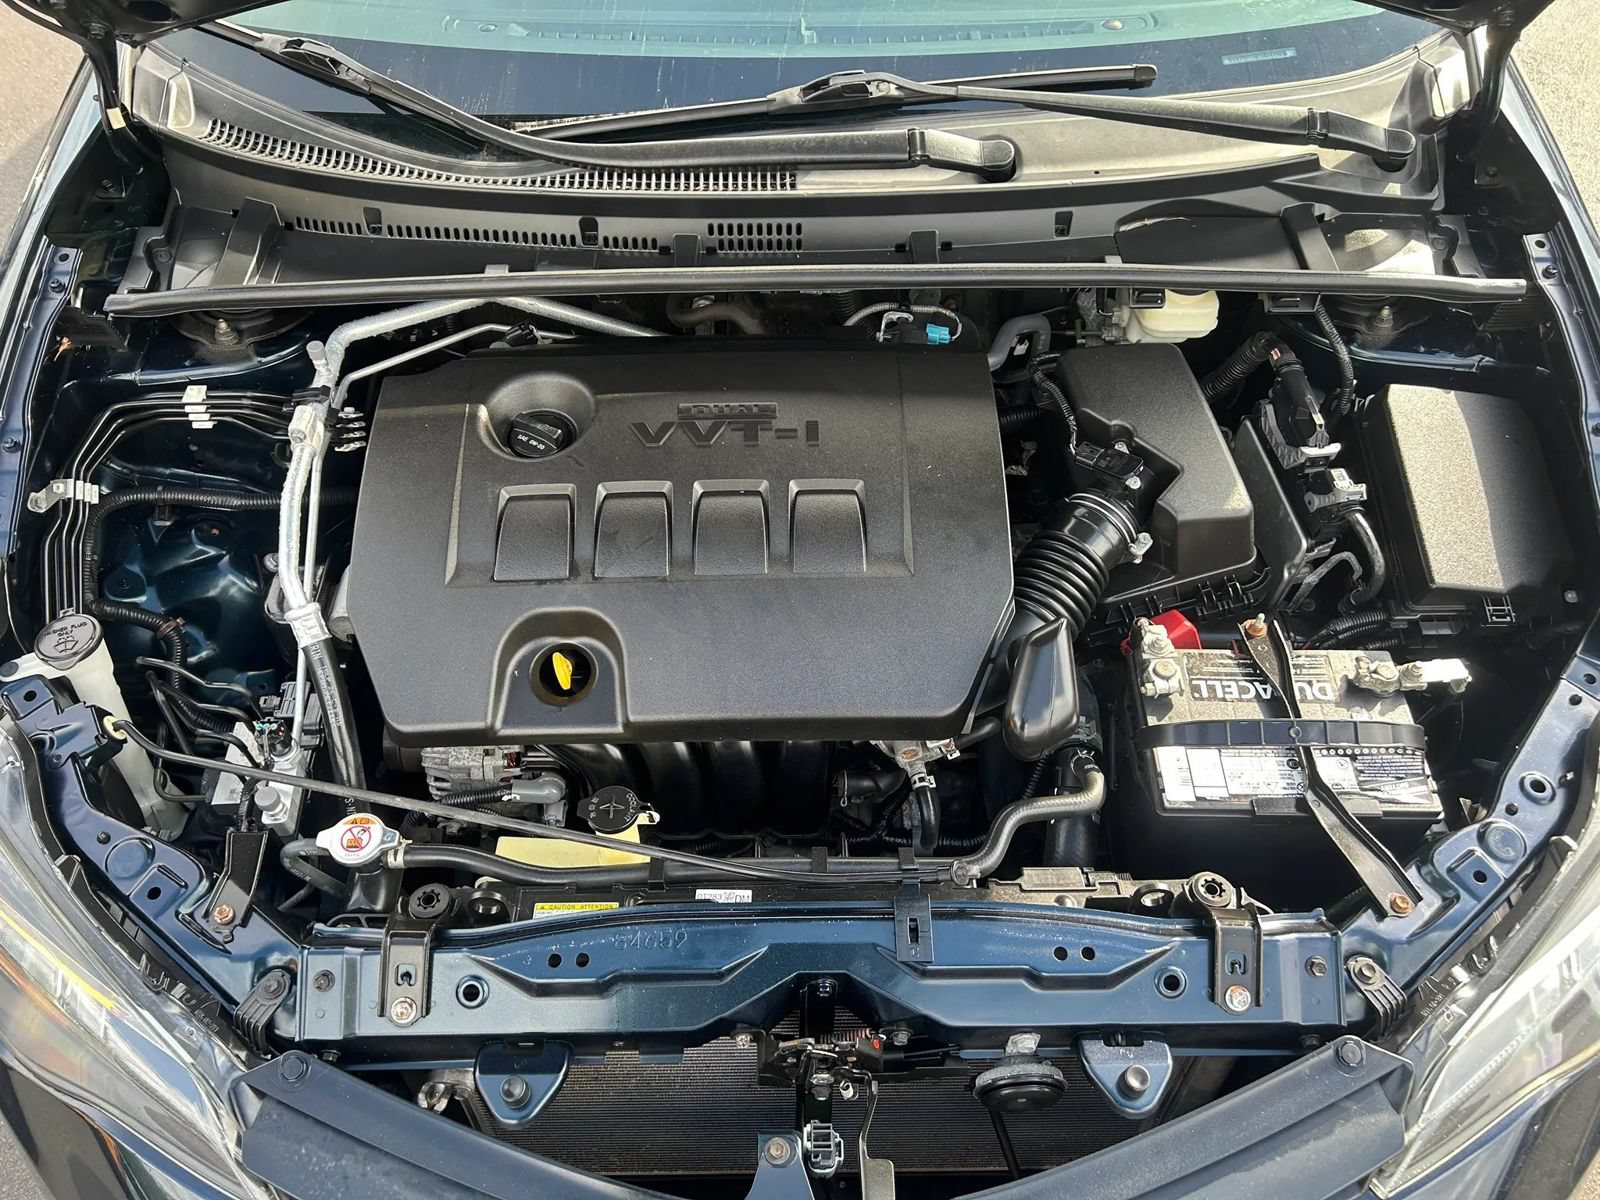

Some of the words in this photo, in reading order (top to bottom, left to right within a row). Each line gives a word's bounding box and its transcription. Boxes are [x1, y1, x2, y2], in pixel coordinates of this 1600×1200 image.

[1191, 679, 1333, 701] DUACELL
[548, 903, 576, 911] CAUTION
[580, 902, 614, 910] ATTENTION
